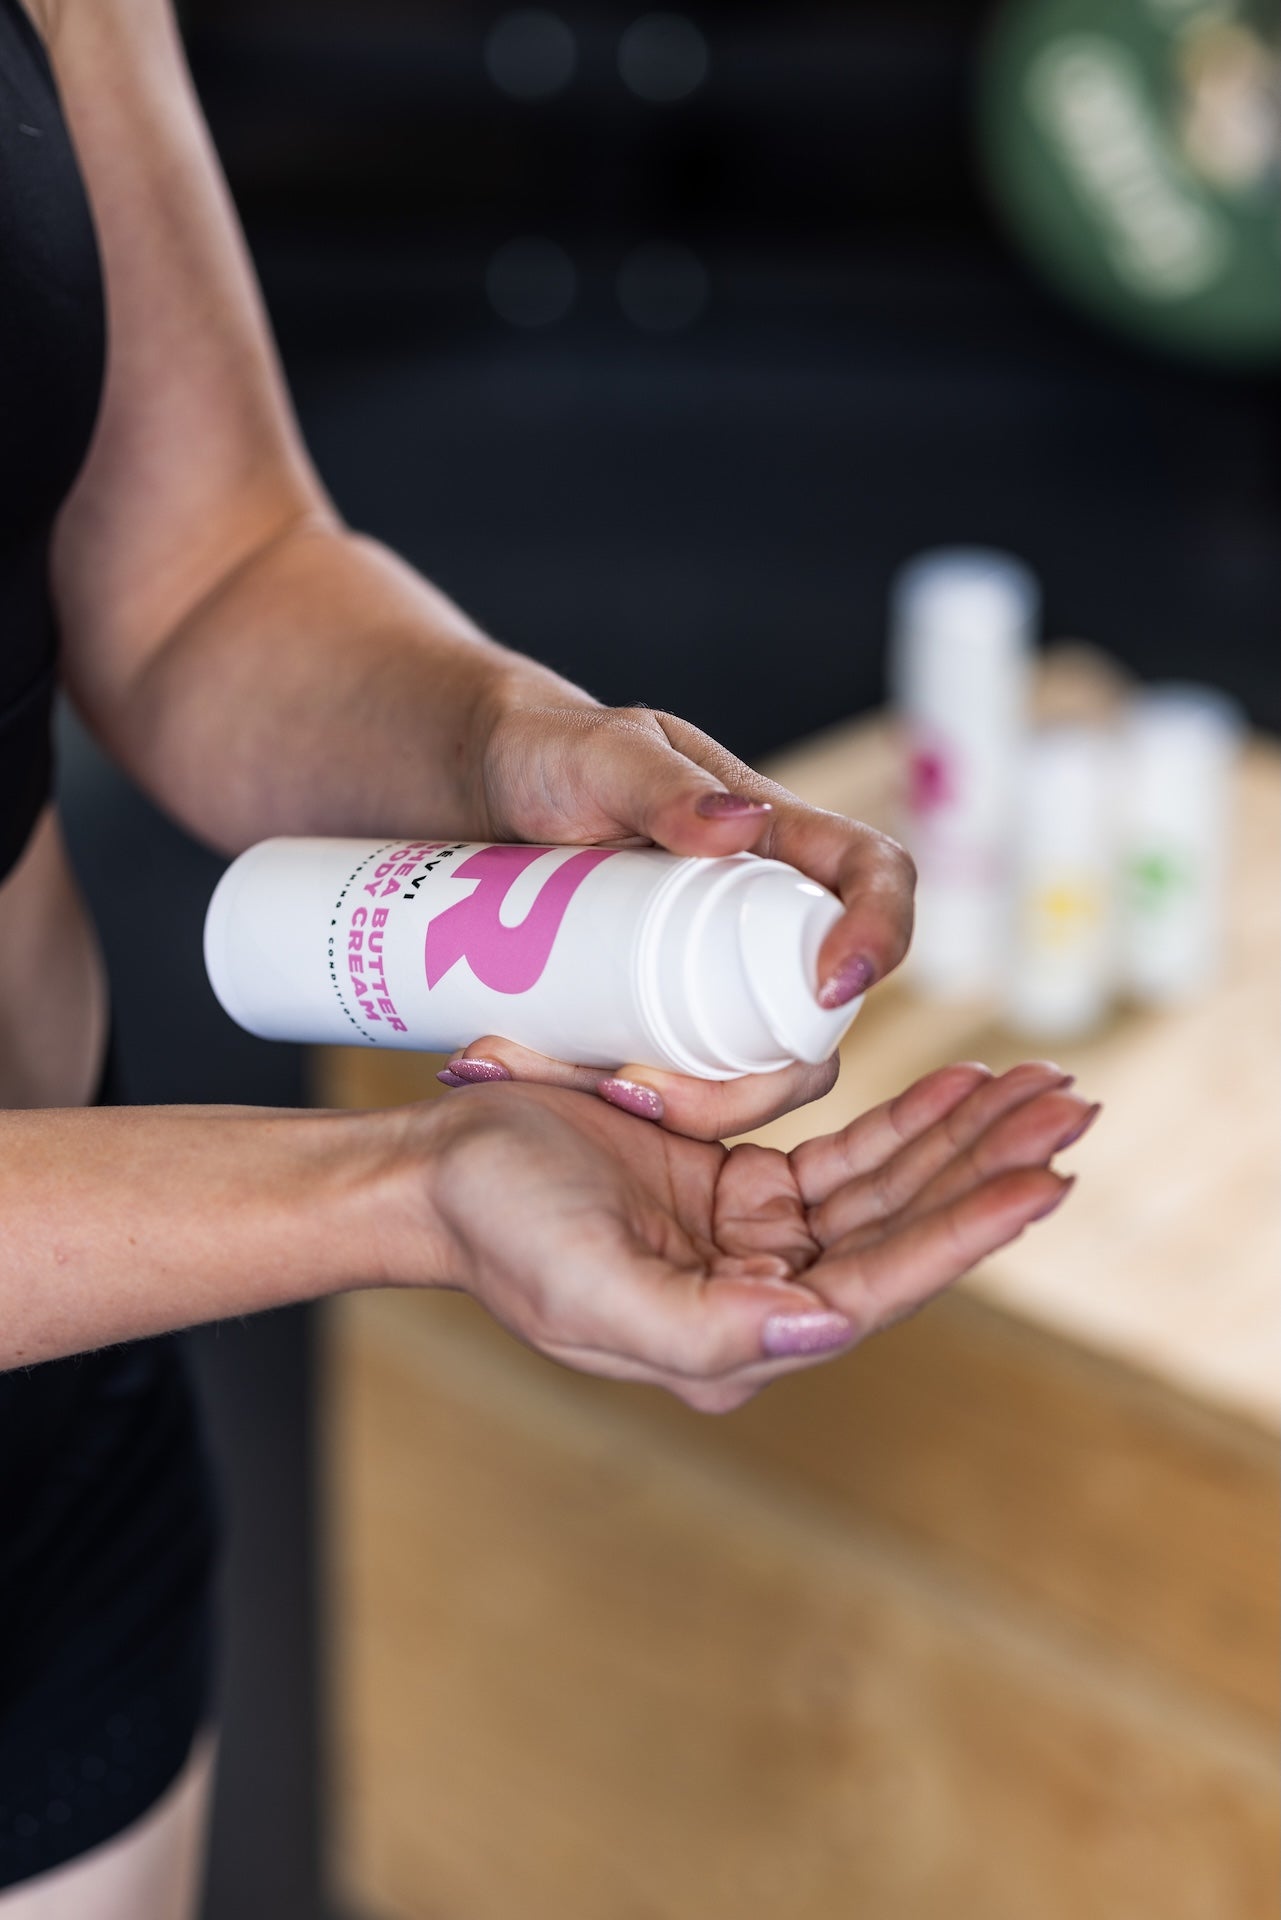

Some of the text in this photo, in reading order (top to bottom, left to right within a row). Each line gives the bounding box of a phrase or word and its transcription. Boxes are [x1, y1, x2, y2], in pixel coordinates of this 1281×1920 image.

[348, 842, 418, 1021] BODY CREAM
[368, 842, 448, 1032] SHEA BUTTER
